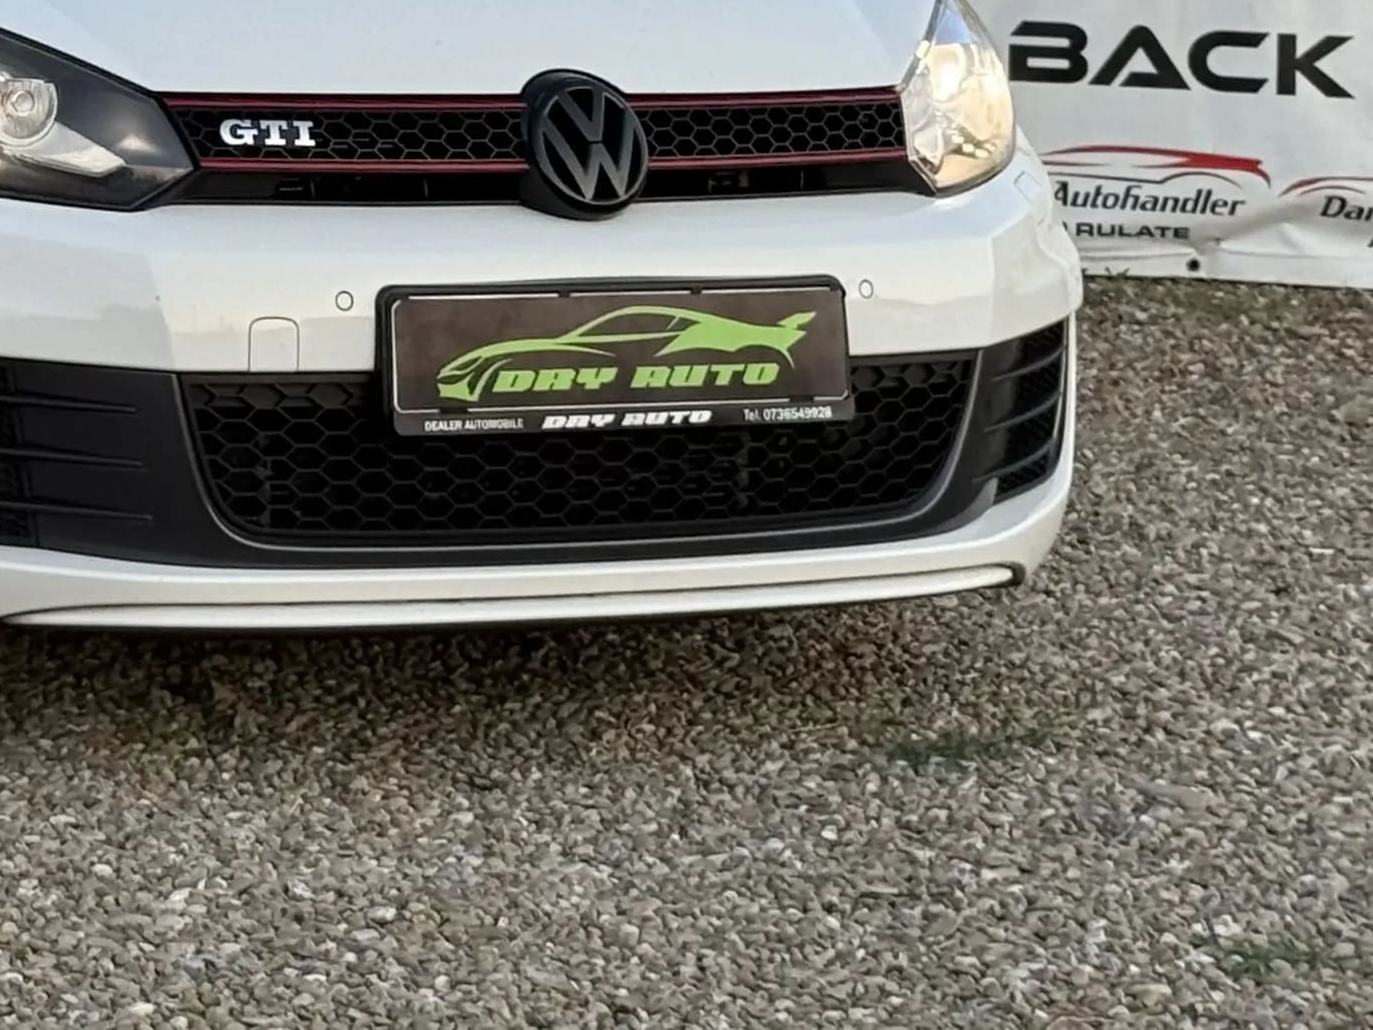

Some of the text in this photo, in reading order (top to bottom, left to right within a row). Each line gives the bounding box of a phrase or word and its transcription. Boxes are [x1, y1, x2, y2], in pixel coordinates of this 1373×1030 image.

[1009, 21, 1355, 99] BACK
[220, 119, 316, 147] GTI
[1054, 180, 1246, 217] Autohandler
[1076, 221, 1190, 240] RULATE
[630, 363, 780, 389] AUTO
[425, 418, 462, 432] DEALER
[464, 417, 524, 431] AUTOMOBILE
[621, 410, 712, 427] AUTO
